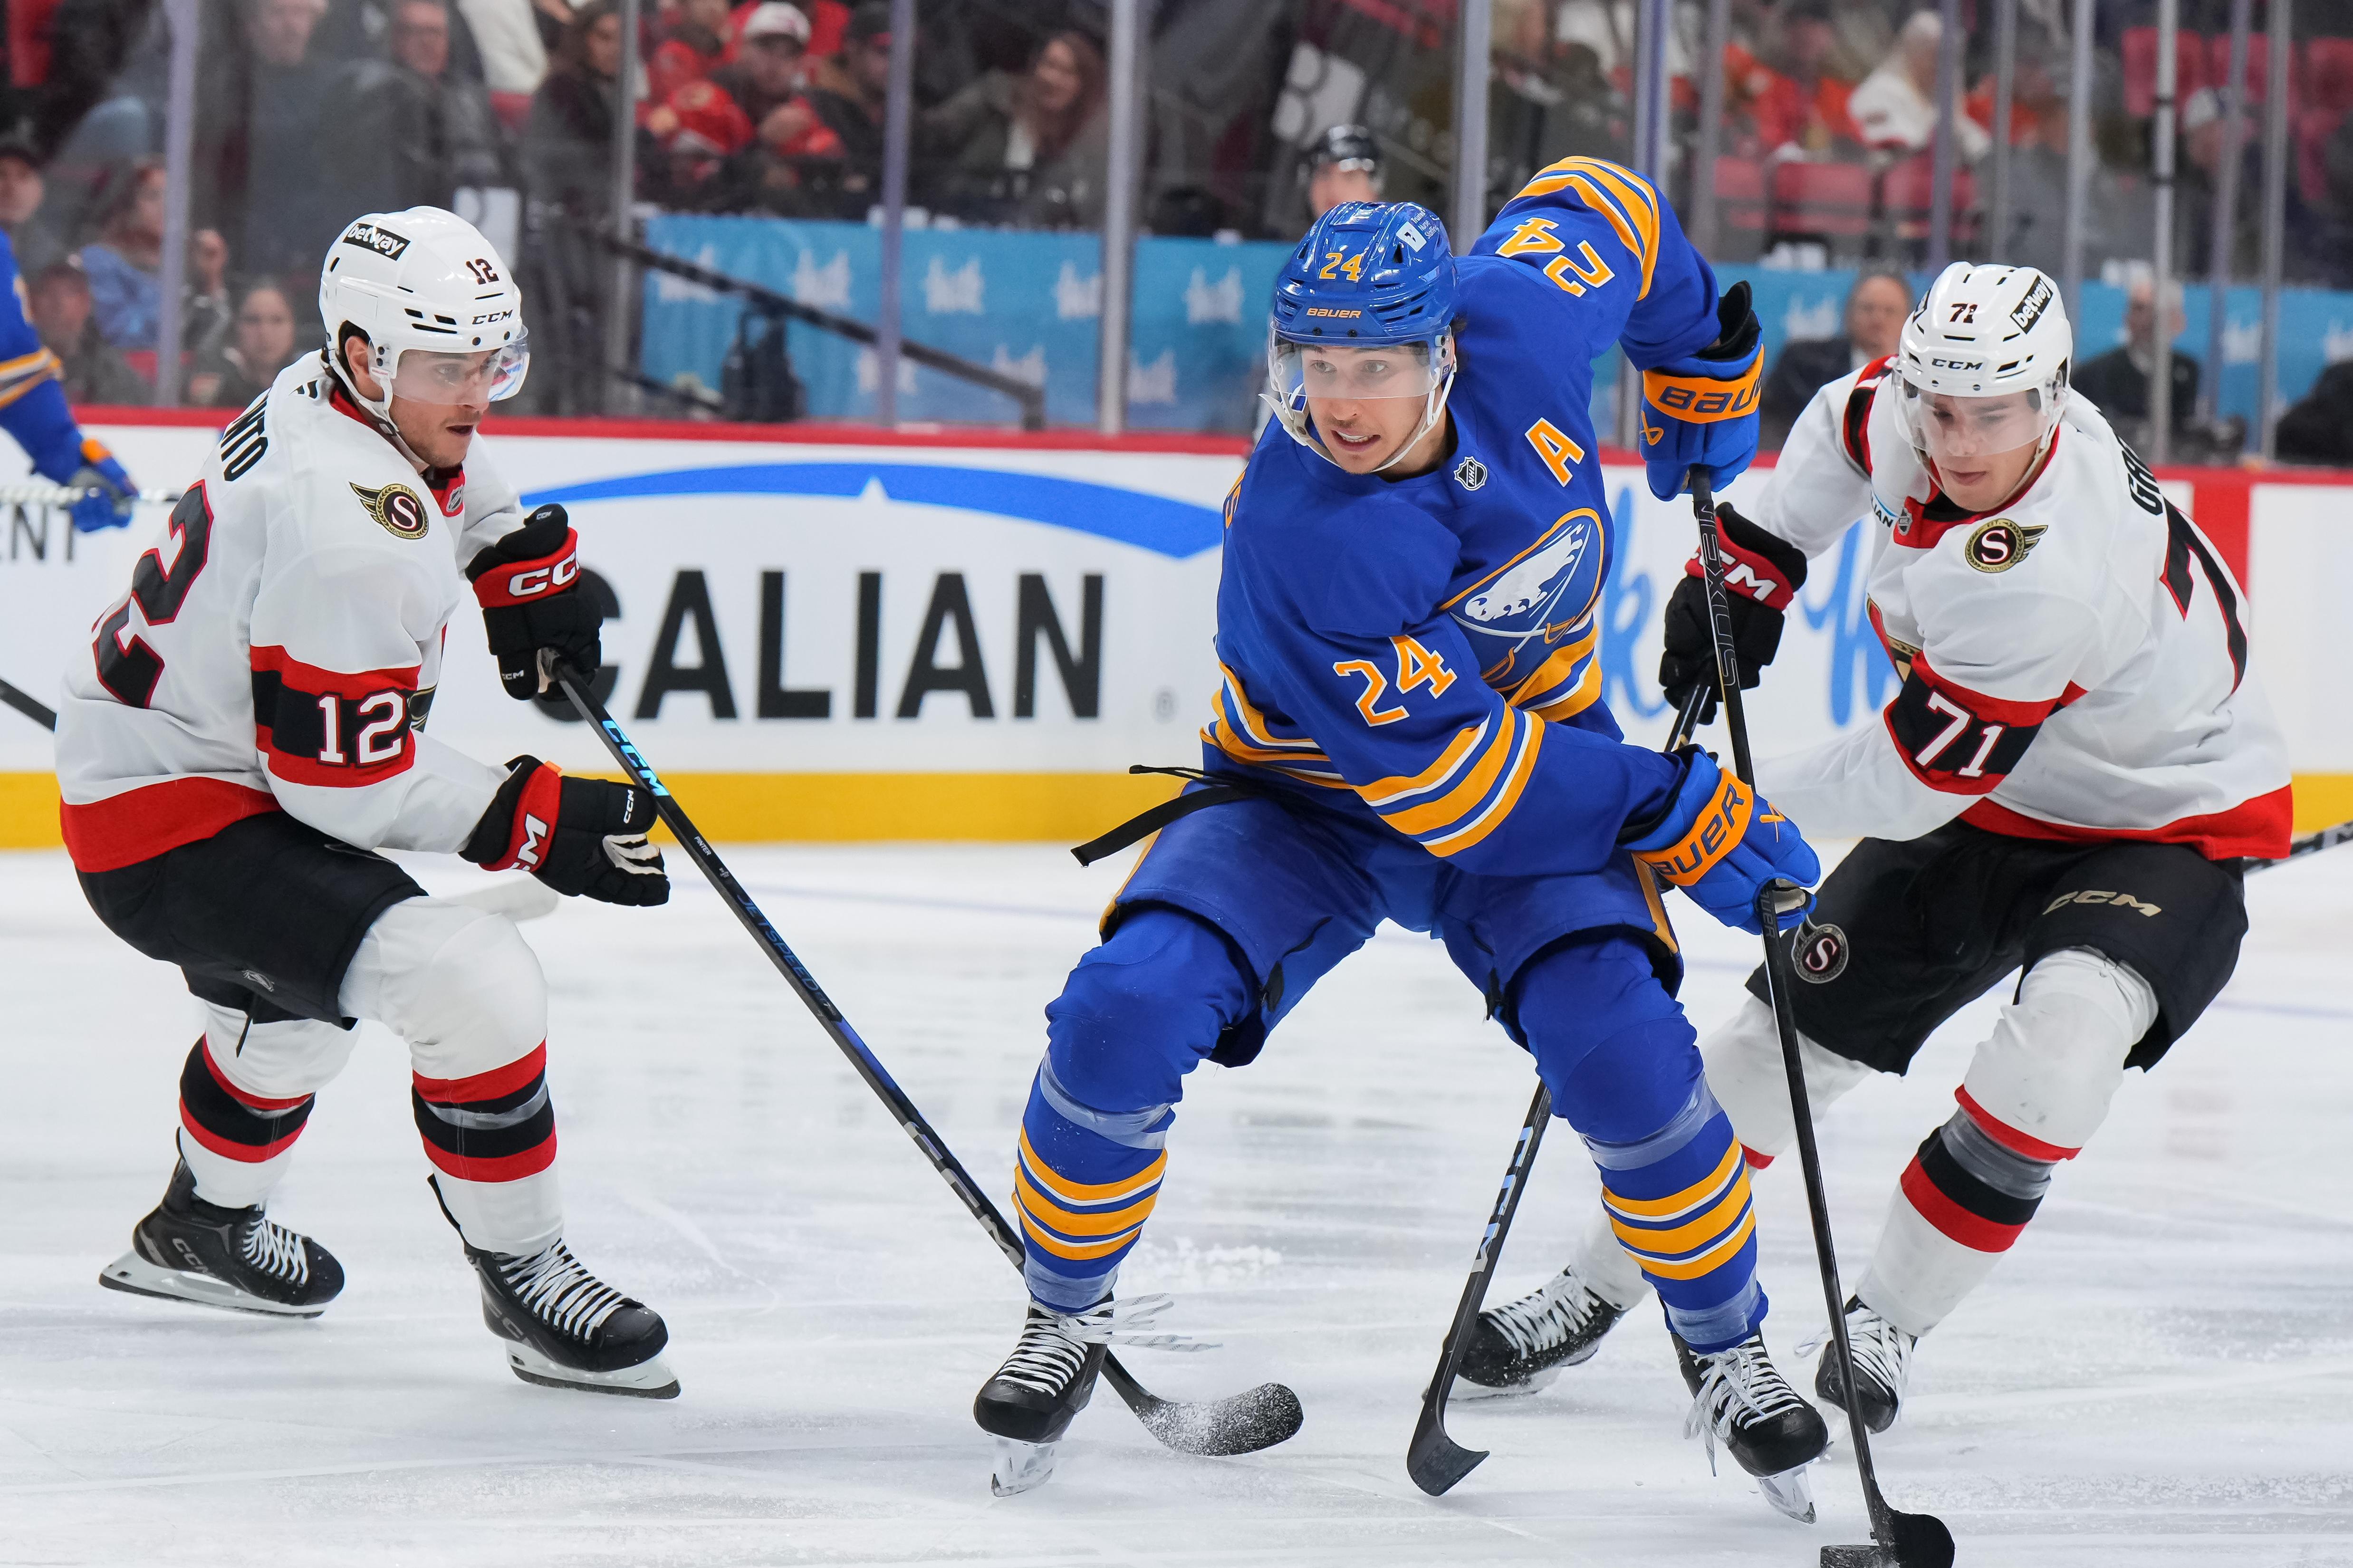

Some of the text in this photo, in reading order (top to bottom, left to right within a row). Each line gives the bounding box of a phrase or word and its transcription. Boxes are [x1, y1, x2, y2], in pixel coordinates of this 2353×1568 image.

[348, 223, 405, 255] betway
[1496, 217, 1615, 298] 24
[466, 258, 499, 285] 12
[1318, 252, 1364, 283] 24
[471, 309, 514, 325] CCM
[1950, 303, 1978, 324] 71
[2012, 279, 2052, 328] betway
[1932, 357, 1983, 370] CCM
[1525, 417, 1585, 487] A
[0, 501, 75, 562] NT
[508, 549, 581, 597] CC
[1333, 635, 1457, 727] 24
[317, 690, 406, 768] 12
[1915, 689, 2005, 779] 71
[602, 720, 672, 797] CCM
[623, 789, 635, 824] CCM
[2042, 890, 2162, 918] CCM
[736, 894, 819, 991] JETSPEED
